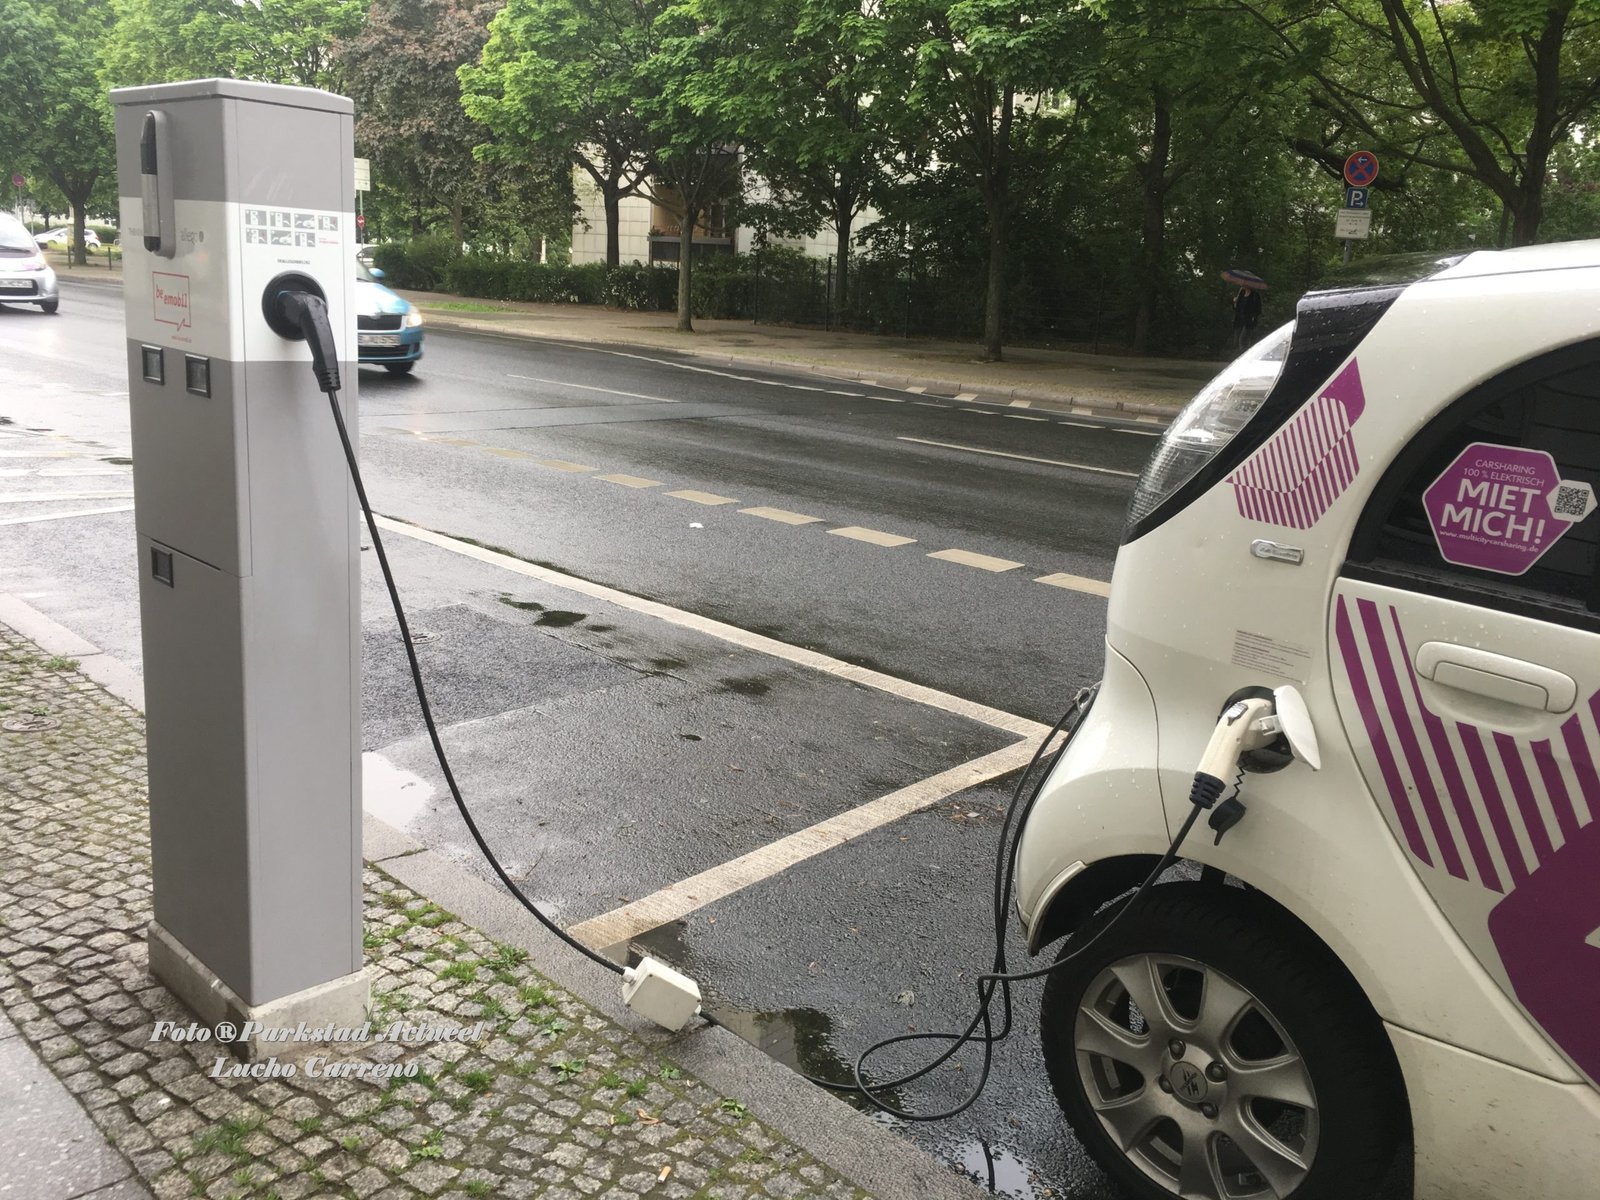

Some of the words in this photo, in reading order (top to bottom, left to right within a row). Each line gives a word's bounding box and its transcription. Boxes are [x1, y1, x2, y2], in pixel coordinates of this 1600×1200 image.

[1350, 190, 1363, 206] P
[1463, 467, 1480, 477] 100
[1490, 471, 1545, 487] ELEKTRISCH
[1475, 459, 1536, 475] CARSHARING
[1457, 478, 1541, 514] MIET
[1441, 503, 1546, 544] MICH!
